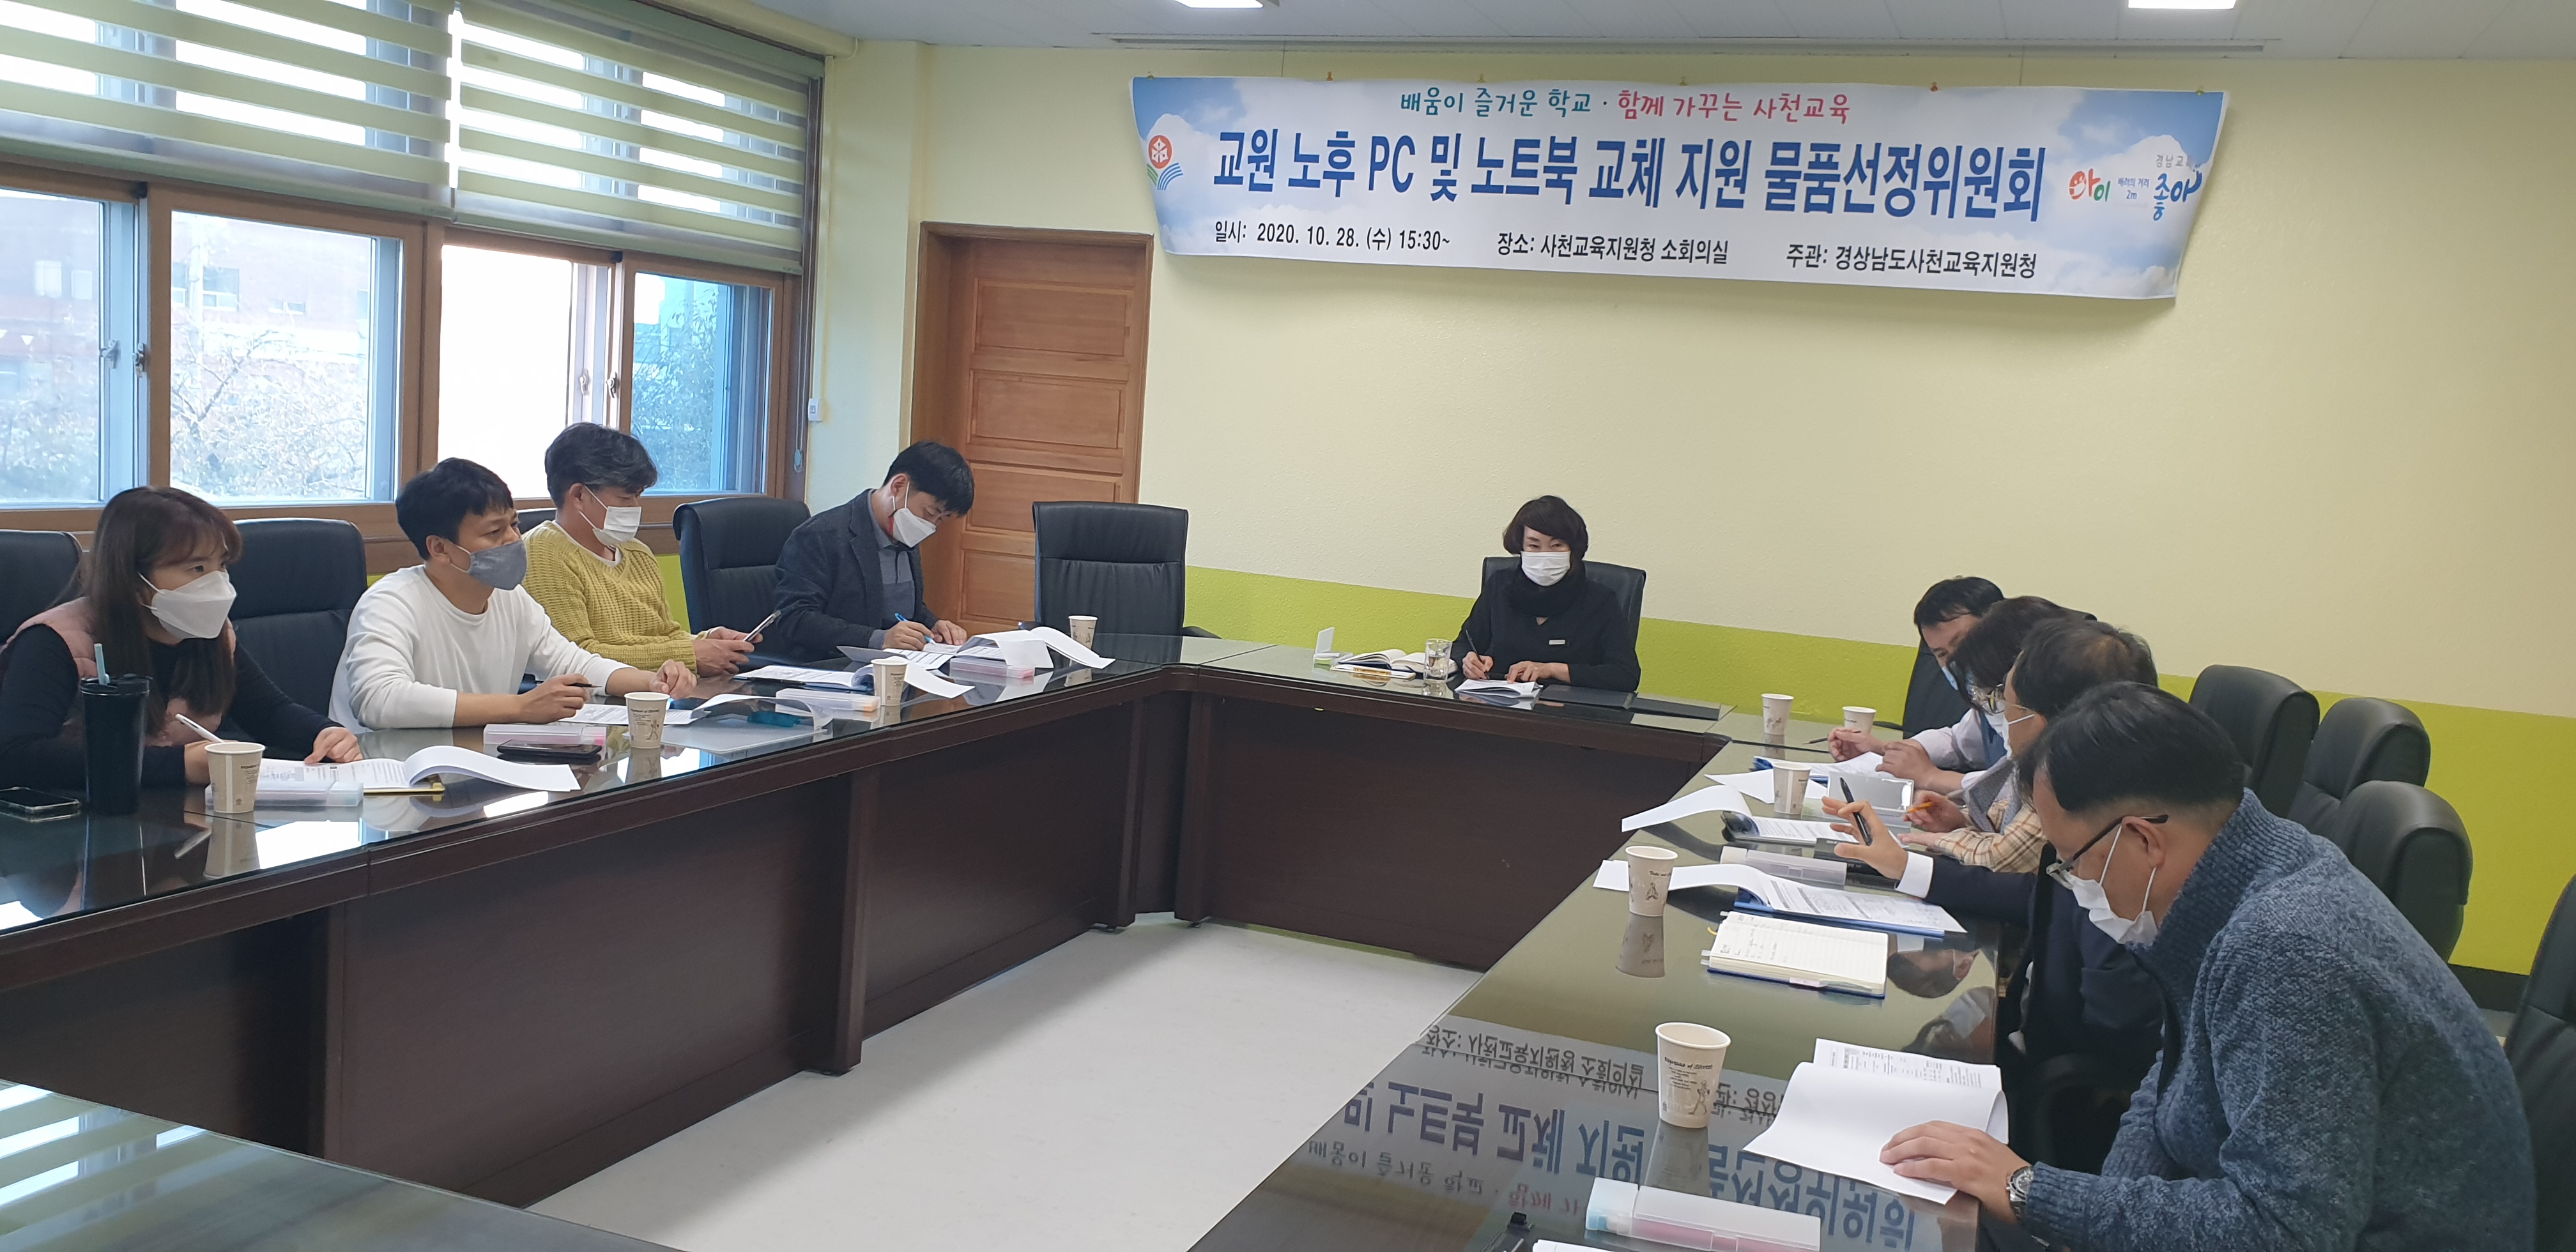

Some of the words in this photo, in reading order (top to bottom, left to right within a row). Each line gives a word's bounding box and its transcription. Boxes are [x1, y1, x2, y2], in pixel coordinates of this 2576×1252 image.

[1400, 87, 1465, 116] 배움이
[1475, 88, 1538, 118] 즐거운
[1549, 89, 1591, 118] 학교
[1618, 90, 1665, 121] 함께
[1673, 93, 1742, 121] 가꾸는
[1753, 93, 1850, 124] 사천교육
[1213, 128, 1279, 192] 교원
[1287, 130, 1356, 198] 노후
[1368, 135, 1416, 193] PC
[1430, 133, 1462, 202] 및
[1471, 135, 1579, 205] 노트북
[1588, 137, 1666, 208] 교체
[1675, 138, 1752, 210] 지원
[1765, 141, 2046, 222] 물품선정위원회
[2126, 189, 2138, 199] 2m
[1215, 220, 1248, 244] 일시:
[1256, 222, 1300, 244] 2020.
[1307, 225, 1330, 247] 10.
[1335, 227, 1360, 247] 28.
[1366, 227, 1392, 252] (수)
[1399, 229, 1450, 251] 15:30~
[1497, 232, 1535, 257] 장소:
[1540, 234, 1656, 263] 사천교육지원청
[1660, 238, 1729, 264] 소회의실
[1786, 244, 1828, 270] 주관:
[1834, 245, 2037, 279] 경상남도사천교육지원청
